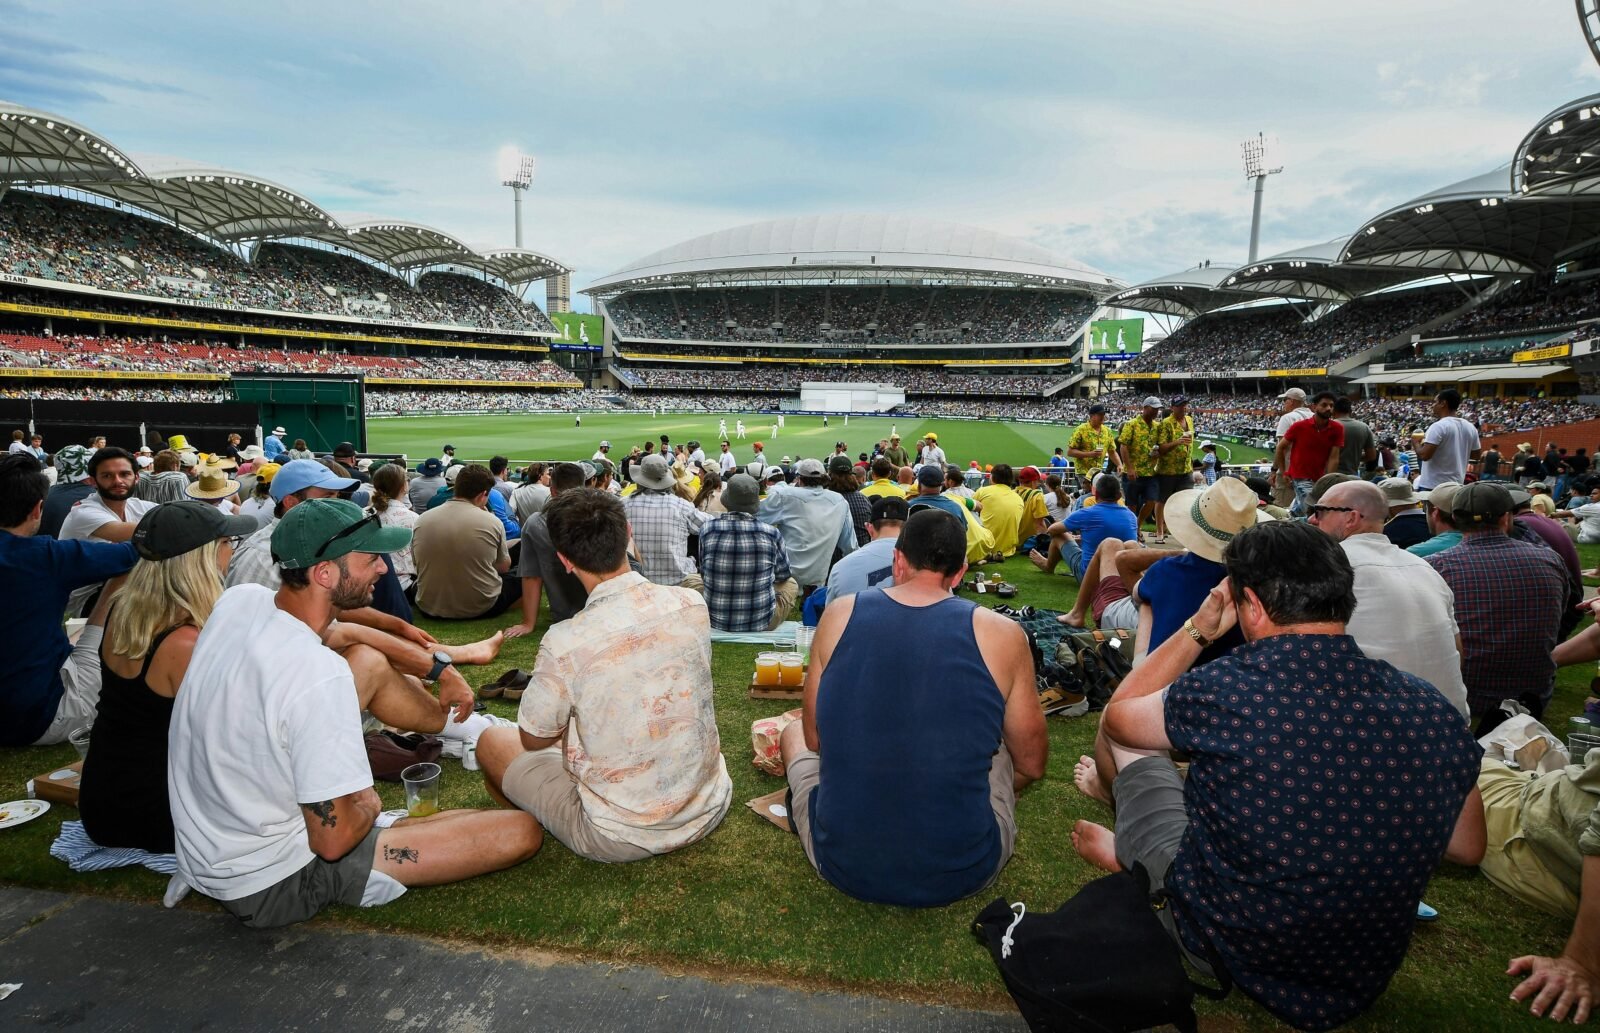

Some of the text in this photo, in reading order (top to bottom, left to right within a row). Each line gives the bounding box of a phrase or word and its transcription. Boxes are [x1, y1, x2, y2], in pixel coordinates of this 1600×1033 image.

[3, 275, 28, 283] STAND
[16, 304, 40, 313] FOREVER
[40, 307, 65, 316] FEARLESS
[227, 304, 248, 312] STAND
[90, 312, 134, 322] FOREVER FEARLESS
